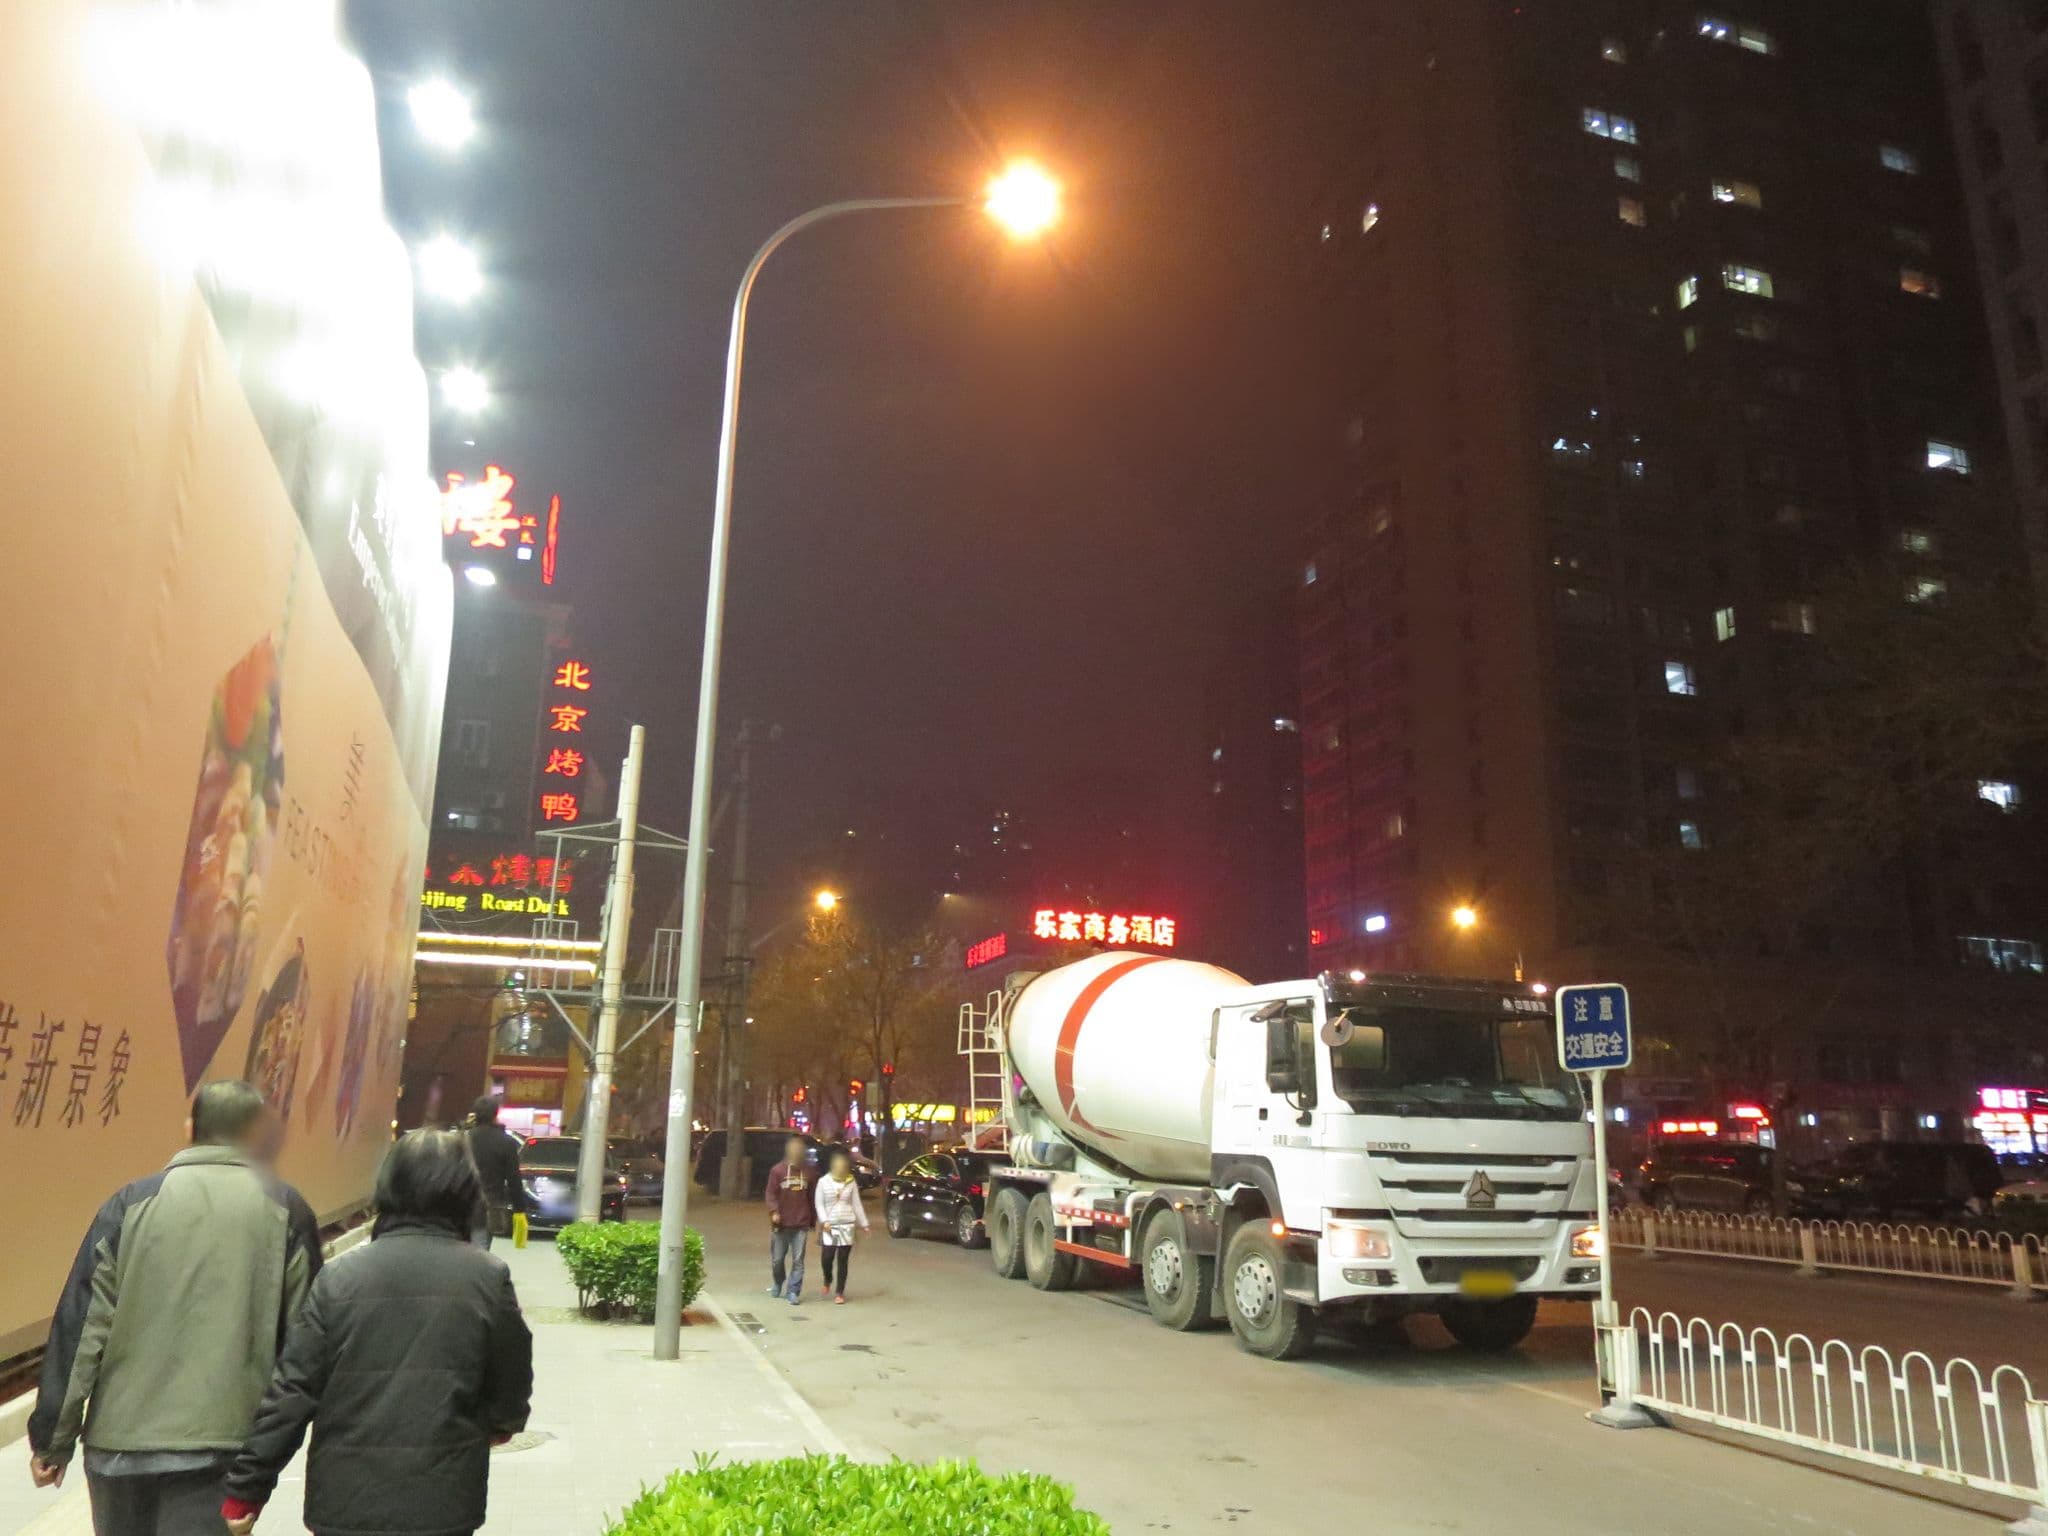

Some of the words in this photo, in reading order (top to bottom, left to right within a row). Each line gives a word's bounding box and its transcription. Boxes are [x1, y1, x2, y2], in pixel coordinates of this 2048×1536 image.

[541, 660, 592, 822] 北京烤鸭
[424, 853, 574, 894] 京烤鸭
[421, 890, 468, 912] eijing
[481, 893, 524, 912] Roast
[1034, 910, 1176, 947] 乐家商务酒店
[1574, 996, 1614, 1022] 注意
[1566, 1031, 1624, 1060] 交通安全
